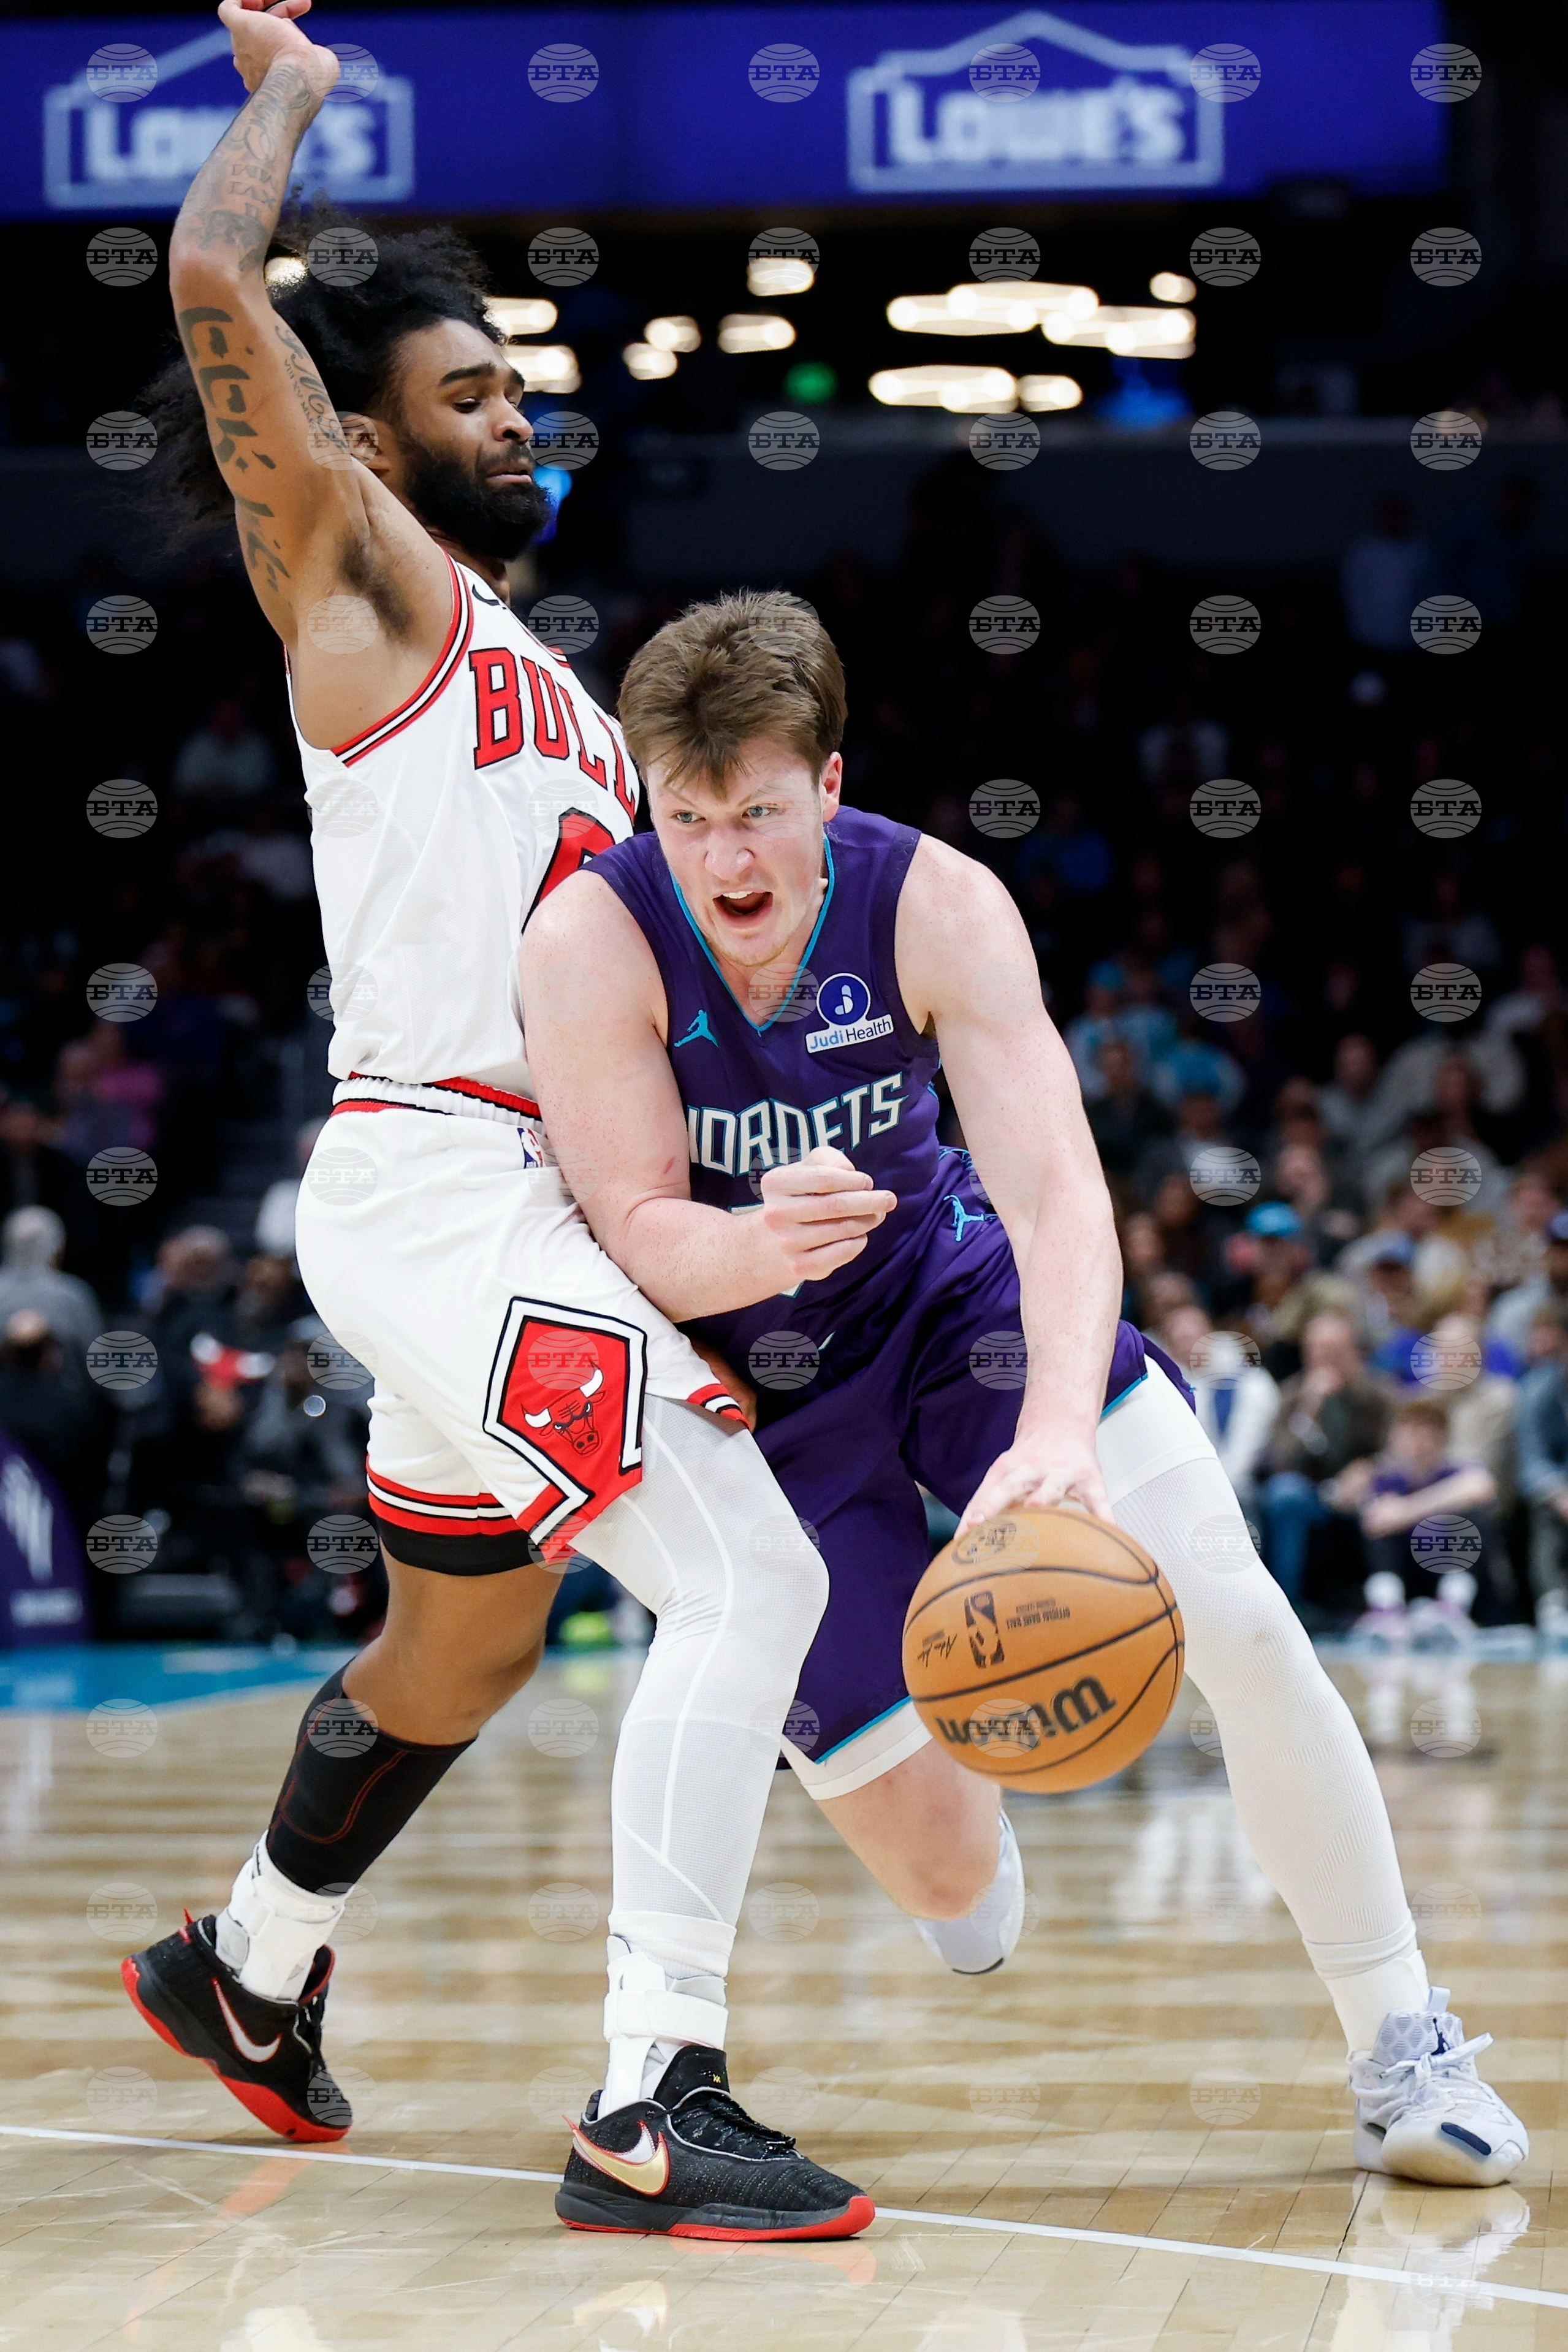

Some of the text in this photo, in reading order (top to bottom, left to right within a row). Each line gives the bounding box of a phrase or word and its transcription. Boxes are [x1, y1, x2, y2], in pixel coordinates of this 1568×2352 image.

[468, 647, 636, 827] BULL
[810, 1018, 891, 1049] Judi Health
[935, 1675, 1117, 1751] Wilson
